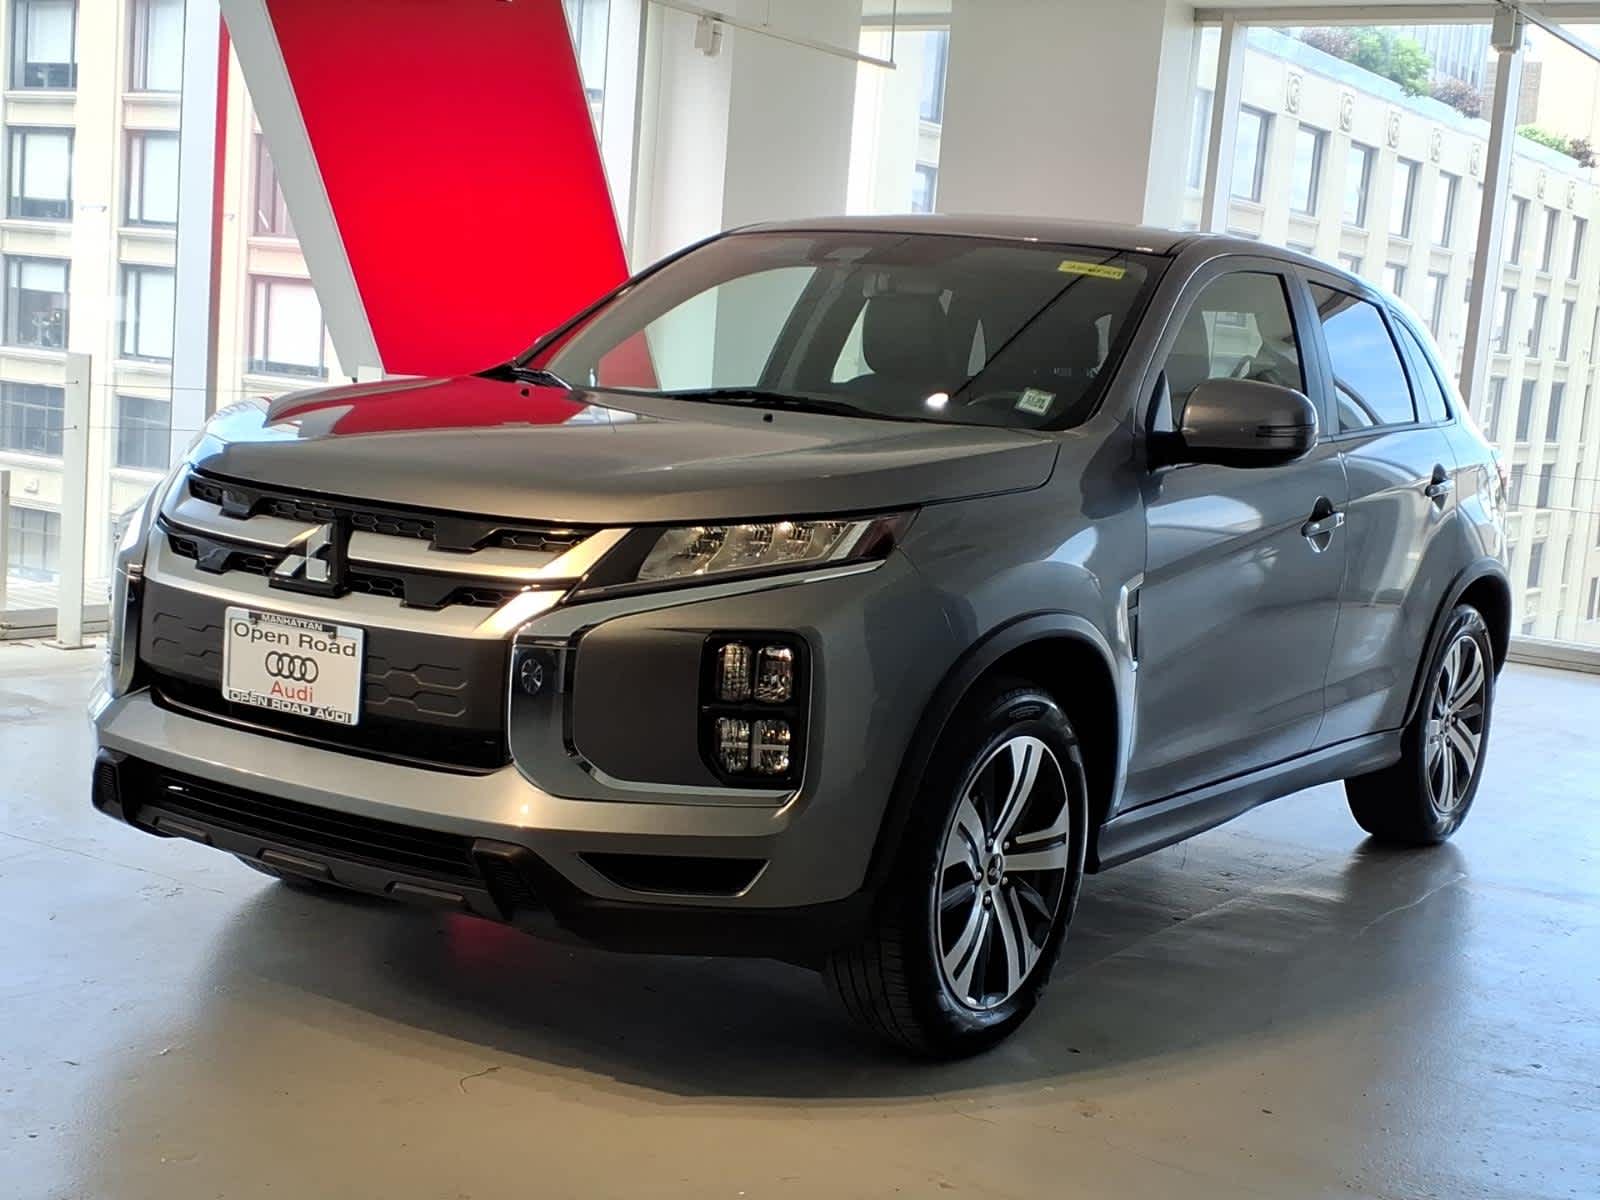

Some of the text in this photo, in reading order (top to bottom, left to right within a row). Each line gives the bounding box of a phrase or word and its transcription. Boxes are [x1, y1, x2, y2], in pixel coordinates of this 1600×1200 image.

[261, 614, 323, 631] MANHATTAN
[233, 622, 357, 657] Open Road
[271, 680, 314, 703] Audi
[230, 690, 351, 724] OPEN ROAD AUDI
